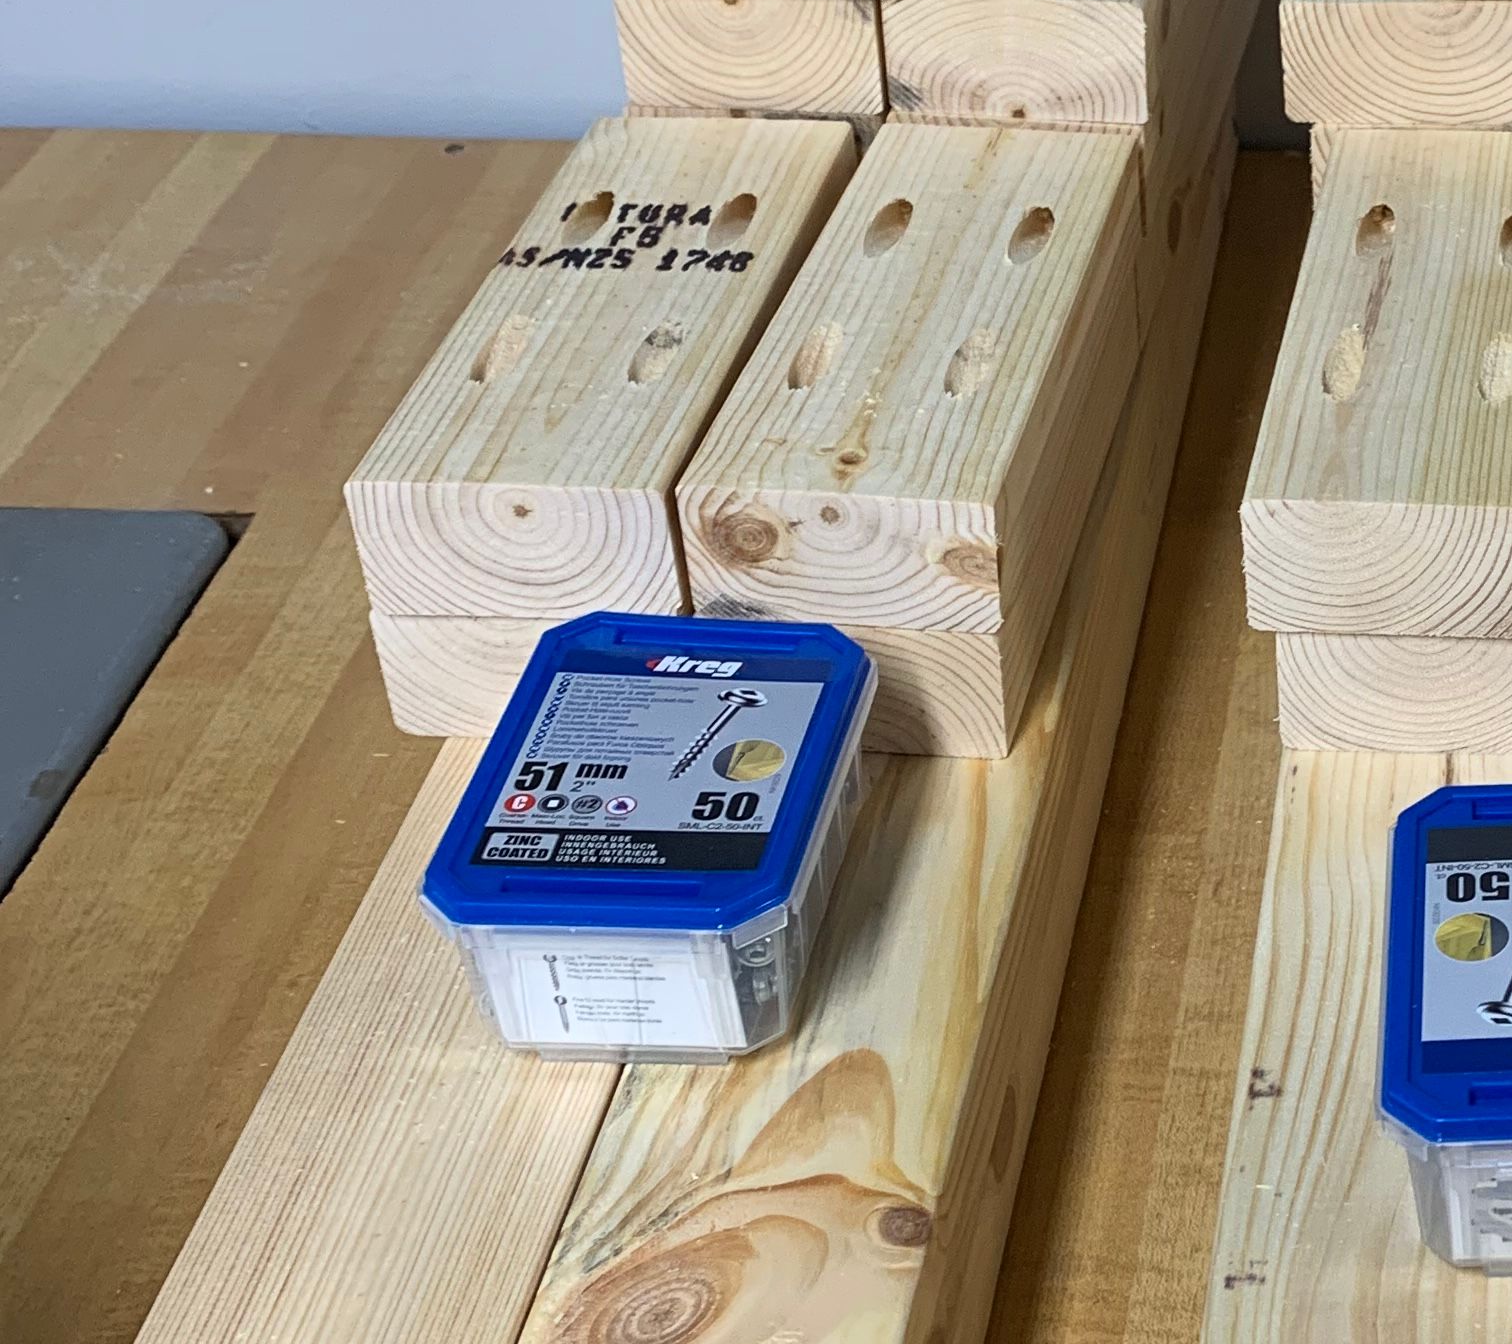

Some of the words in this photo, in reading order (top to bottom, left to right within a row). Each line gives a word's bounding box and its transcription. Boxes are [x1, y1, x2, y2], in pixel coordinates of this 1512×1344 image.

[652, 655, 743, 678] Kreg
[513, 761, 569, 792] 51
[574, 763, 629, 779] mm
[691, 791, 760, 822] 50
[503, 834, 543, 846] ZINC
[564, 834, 607, 842] INDOOR
[609, 835, 632, 843] USE
[560, 841, 656, 850] INNENGEBRAUCH
[487, 846, 549, 858] COATED
[558, 848, 597, 856] USAGE
[599, 856, 667, 865] INTERIORES
[1446, 871, 1510, 903] 50
